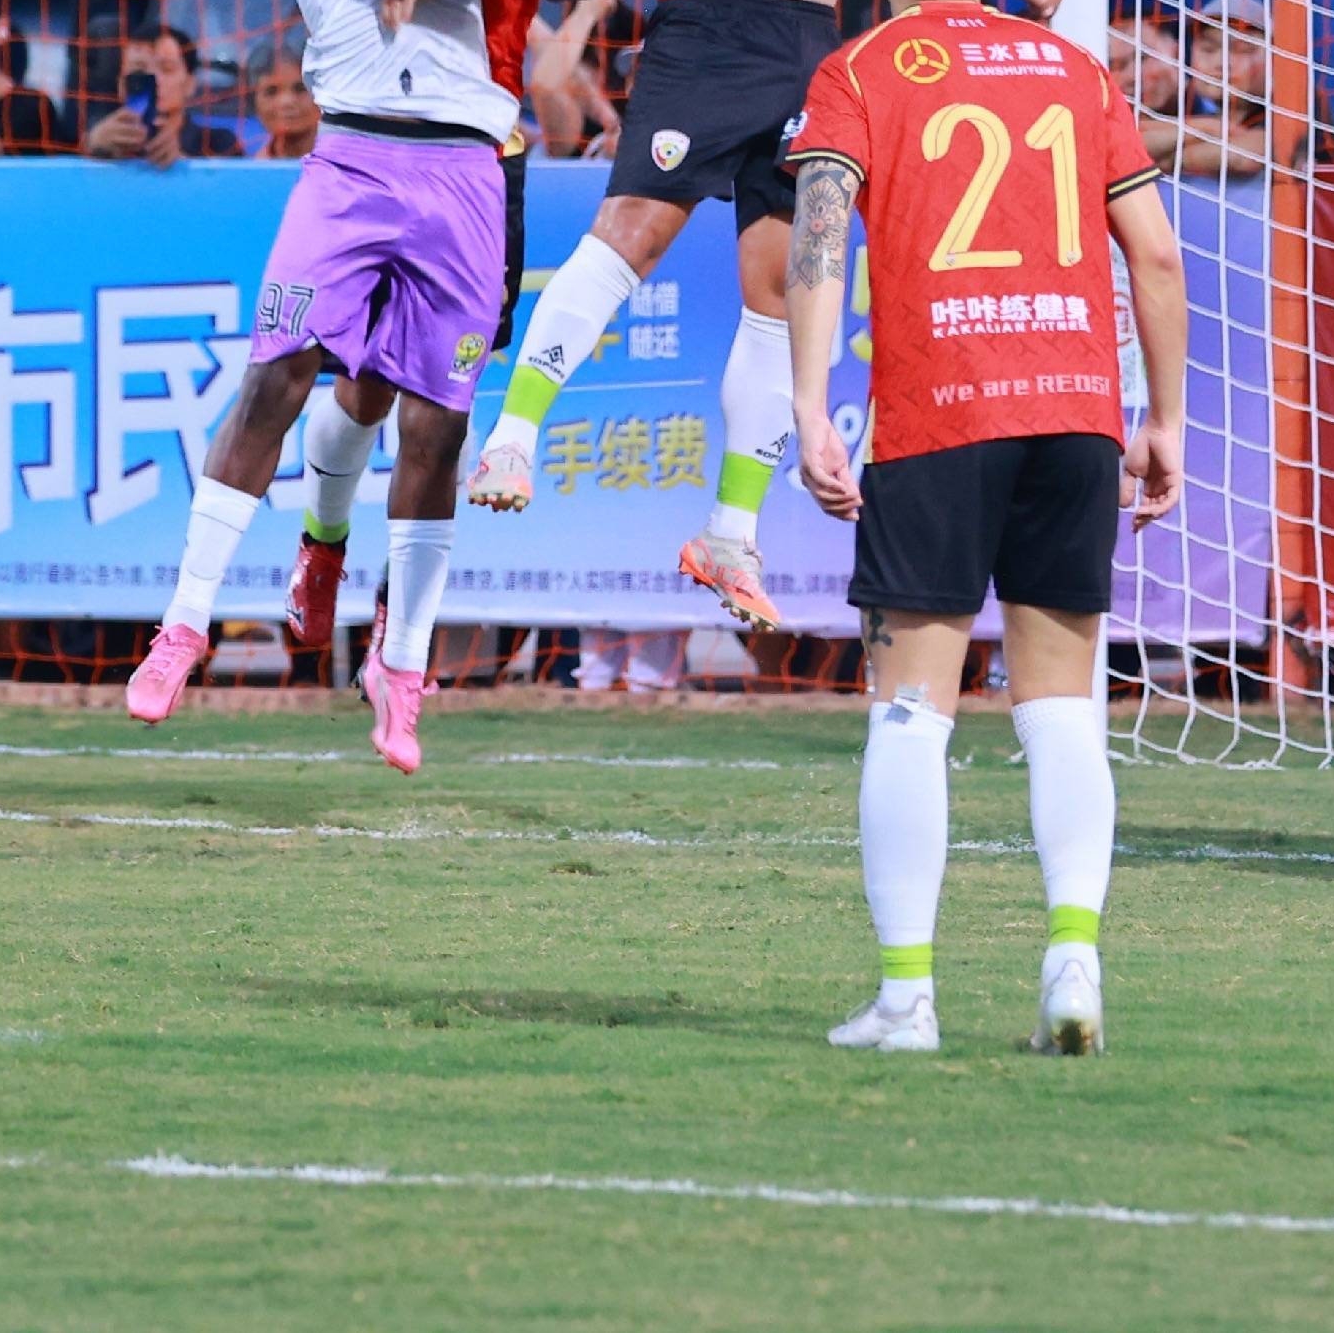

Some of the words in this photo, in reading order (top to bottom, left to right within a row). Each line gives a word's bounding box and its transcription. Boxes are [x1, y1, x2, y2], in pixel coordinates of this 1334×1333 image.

[921, 102, 1083, 272] 21
[258, 282, 315, 338] 97
[930, 293, 1088, 325] 咔咔练健身
[932, 322, 1026, 339] KAKALIAN
[931, 383, 975, 407] We
[982, 378, 1031, 398] are
[542, 411, 709, 495] 手续费
